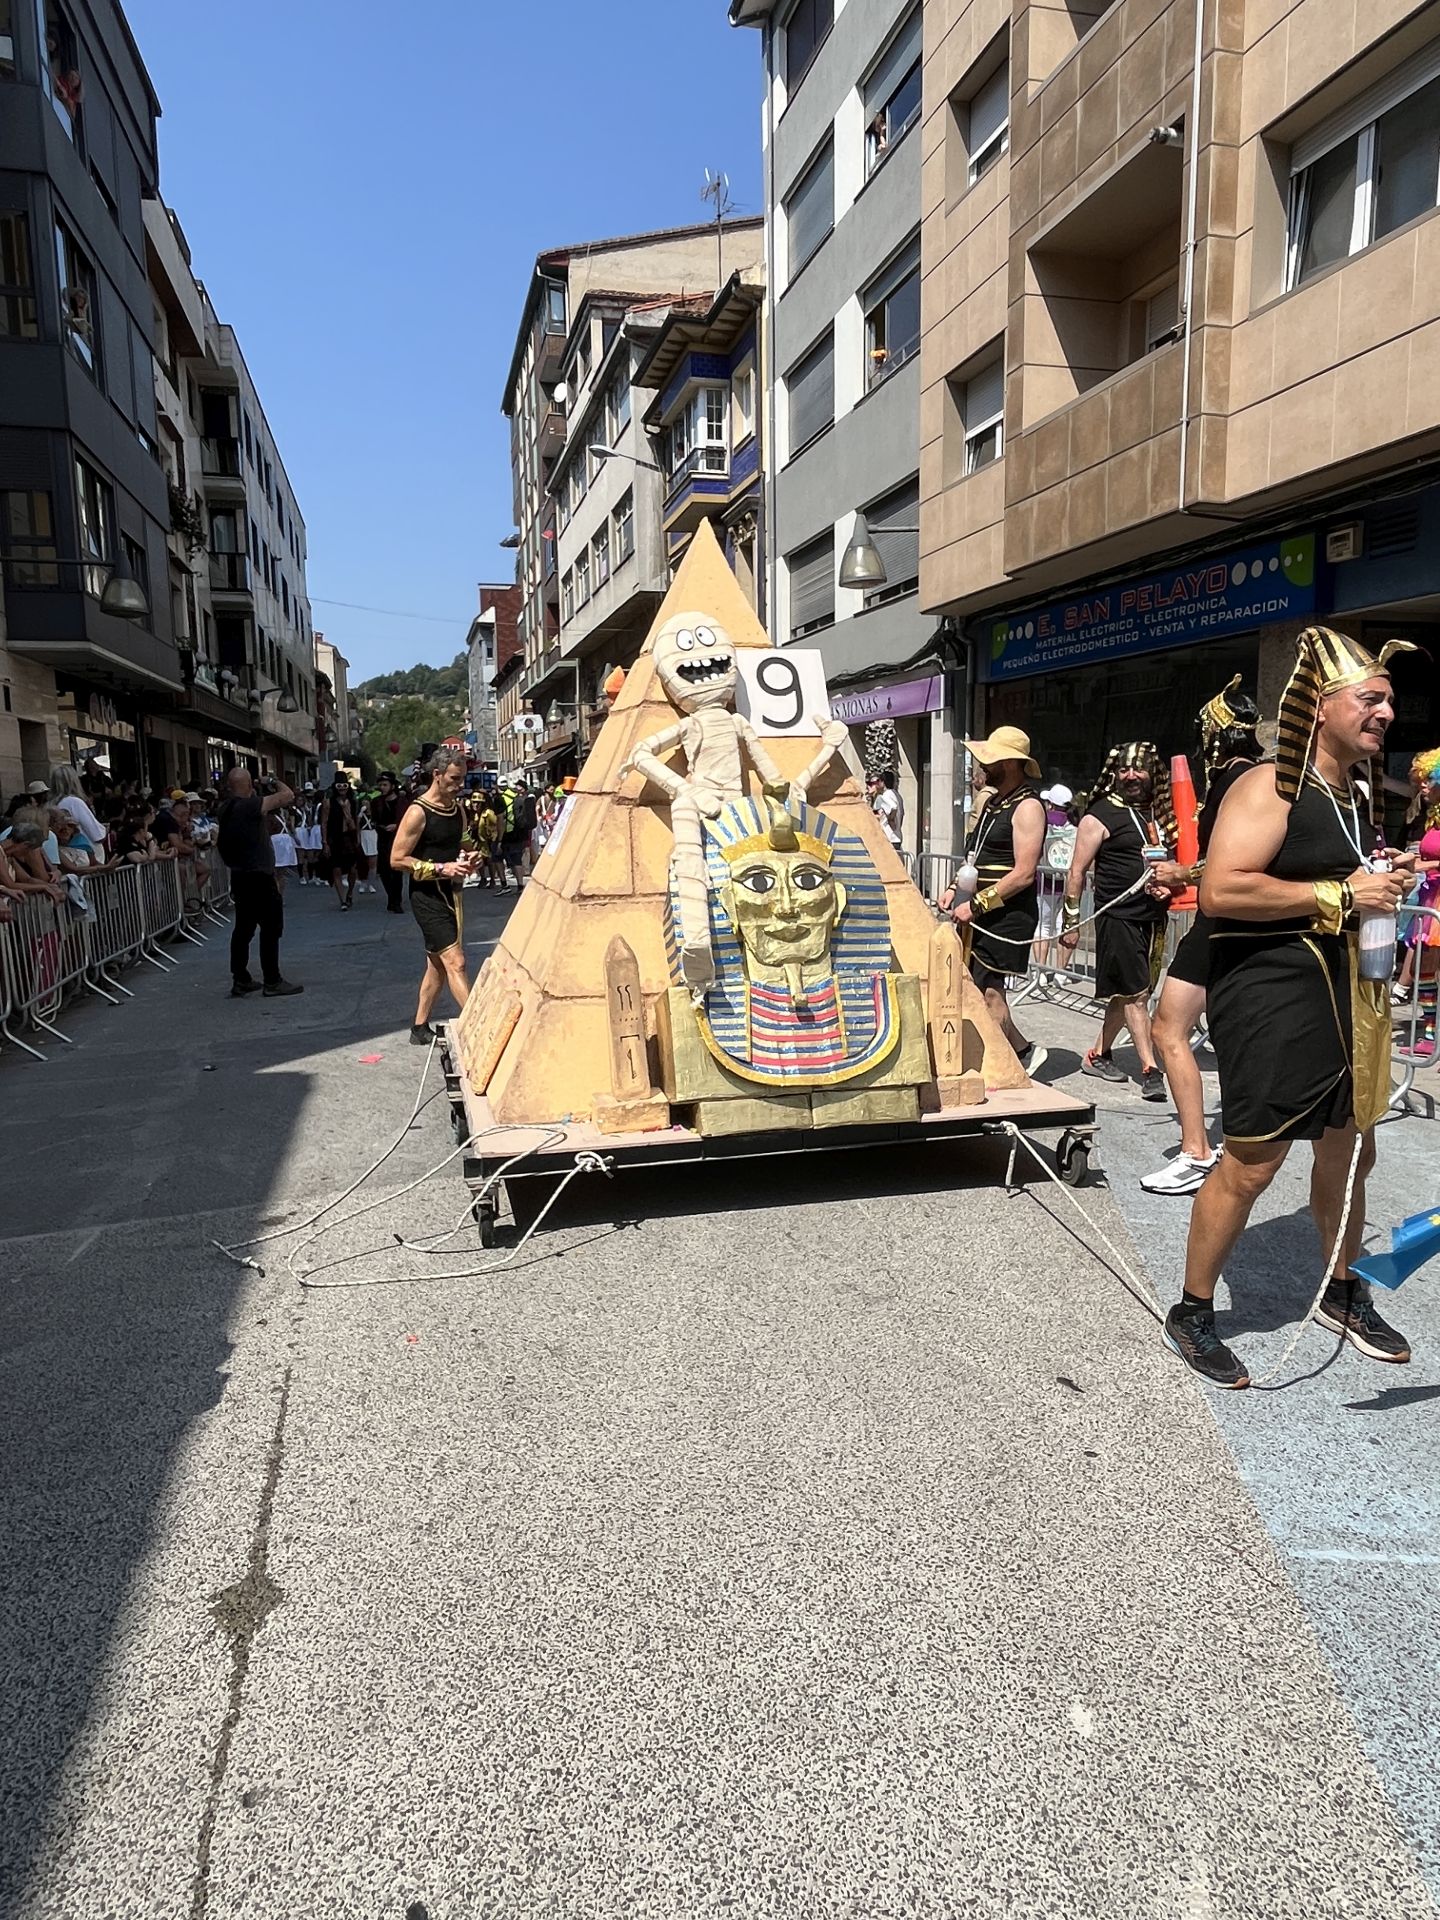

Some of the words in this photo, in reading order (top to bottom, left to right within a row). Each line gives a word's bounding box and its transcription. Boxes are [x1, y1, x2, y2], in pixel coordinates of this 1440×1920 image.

[1035, 633, 1077, 650] MATERIAL
[1079, 617, 1134, 640] ELECTRICO
[1143, 595, 1228, 626] ELECTRONICA
[1042, 631, 1139, 662] ELECTRODOMESTICO
[1148, 620, 1185, 638] VENTA
[1188, 618, 1198, 630] Y
[1200, 596, 1289, 626] REPARACION
[1064, 596, 1110, 630] SAN
[1119, 563, 1228, 616] PELAYO
[756, 656, 804, 730] 9
[840, 695, 879, 719] MONAS
